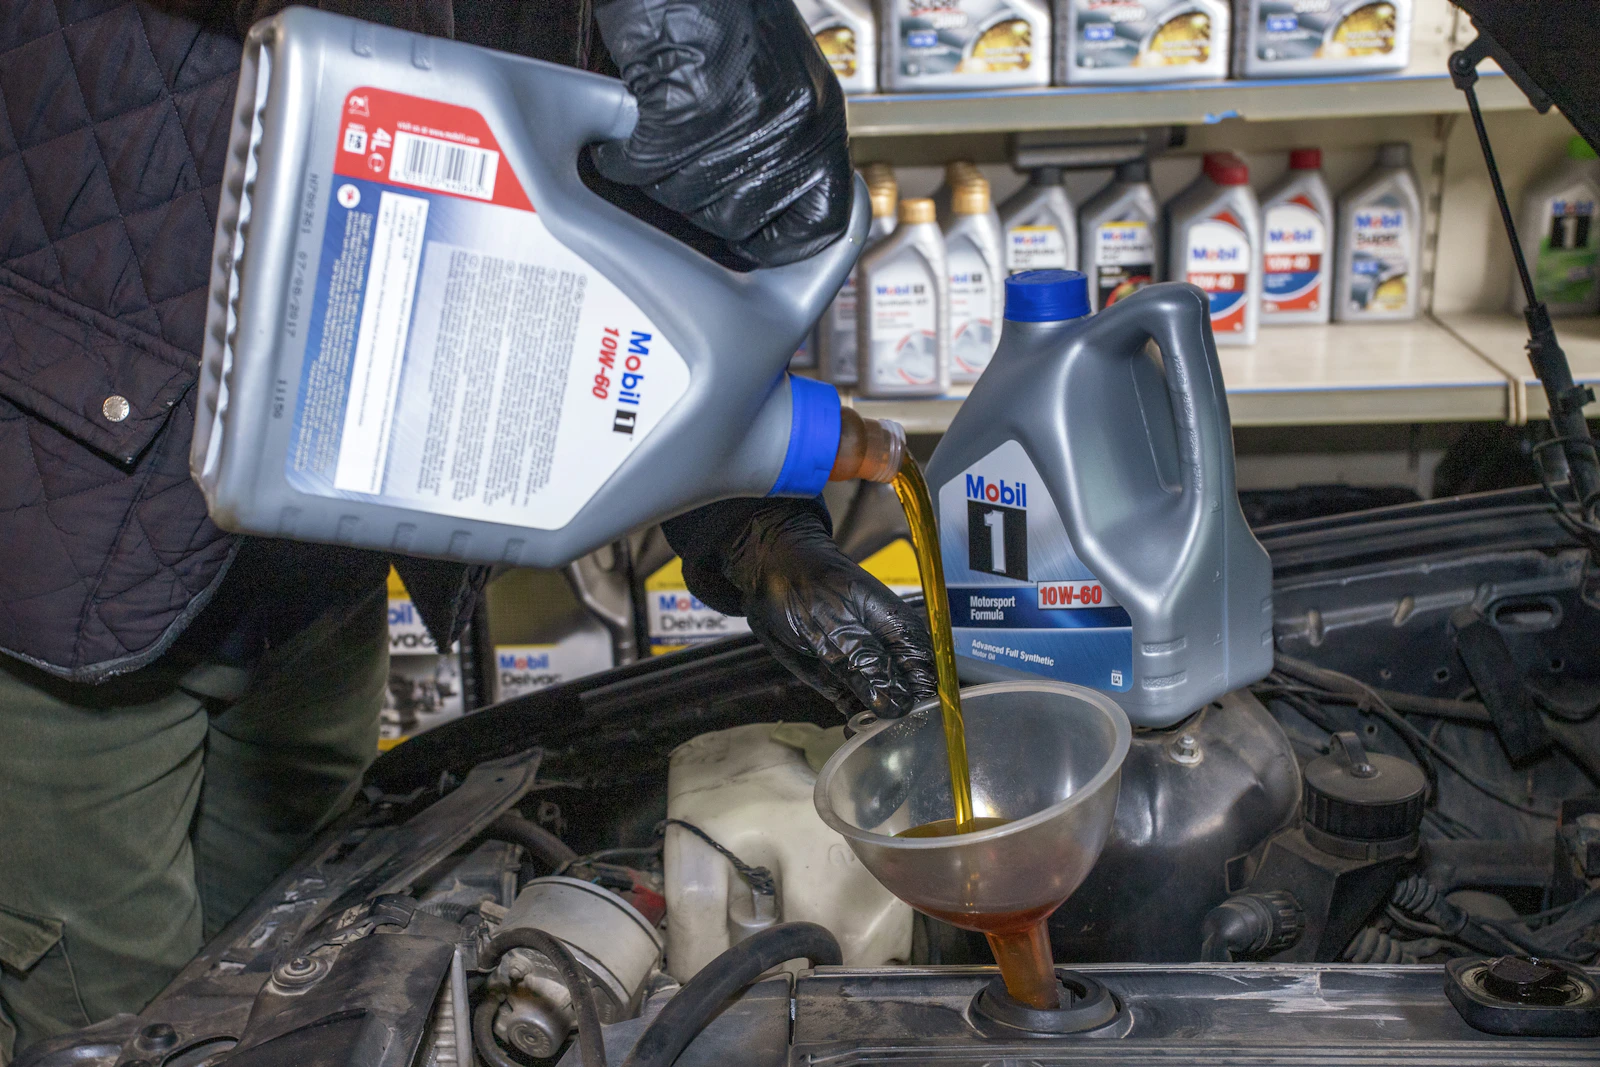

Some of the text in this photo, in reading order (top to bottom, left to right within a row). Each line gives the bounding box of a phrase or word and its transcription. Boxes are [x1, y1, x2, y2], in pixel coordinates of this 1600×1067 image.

[1356, 213, 1402, 228] Mobil
[1013, 235, 1046, 244] Mobil
[1102, 232, 1136, 240] Mobil
[1270, 230, 1313, 242] Mobil
[1193, 248, 1237, 260] Mobil
[876, 285, 909, 295] Mobil
[592, 327, 620, 400] 10W-60
[618, 331, 652, 404] Mobil
[966, 474, 1027, 508] Mobil
[970, 596, 1016, 609] Motorsport
[1040, 585, 1102, 605] 10W-60
[658, 594, 714, 612] Mob
[970, 609, 1004, 620] Formula
[661, 614, 727, 632] Delvac
[971, 639, 1054, 666] Advanced Full Synthetic
[972, 649, 987, 659] Motor
[500, 654, 549, 669] Mobil
